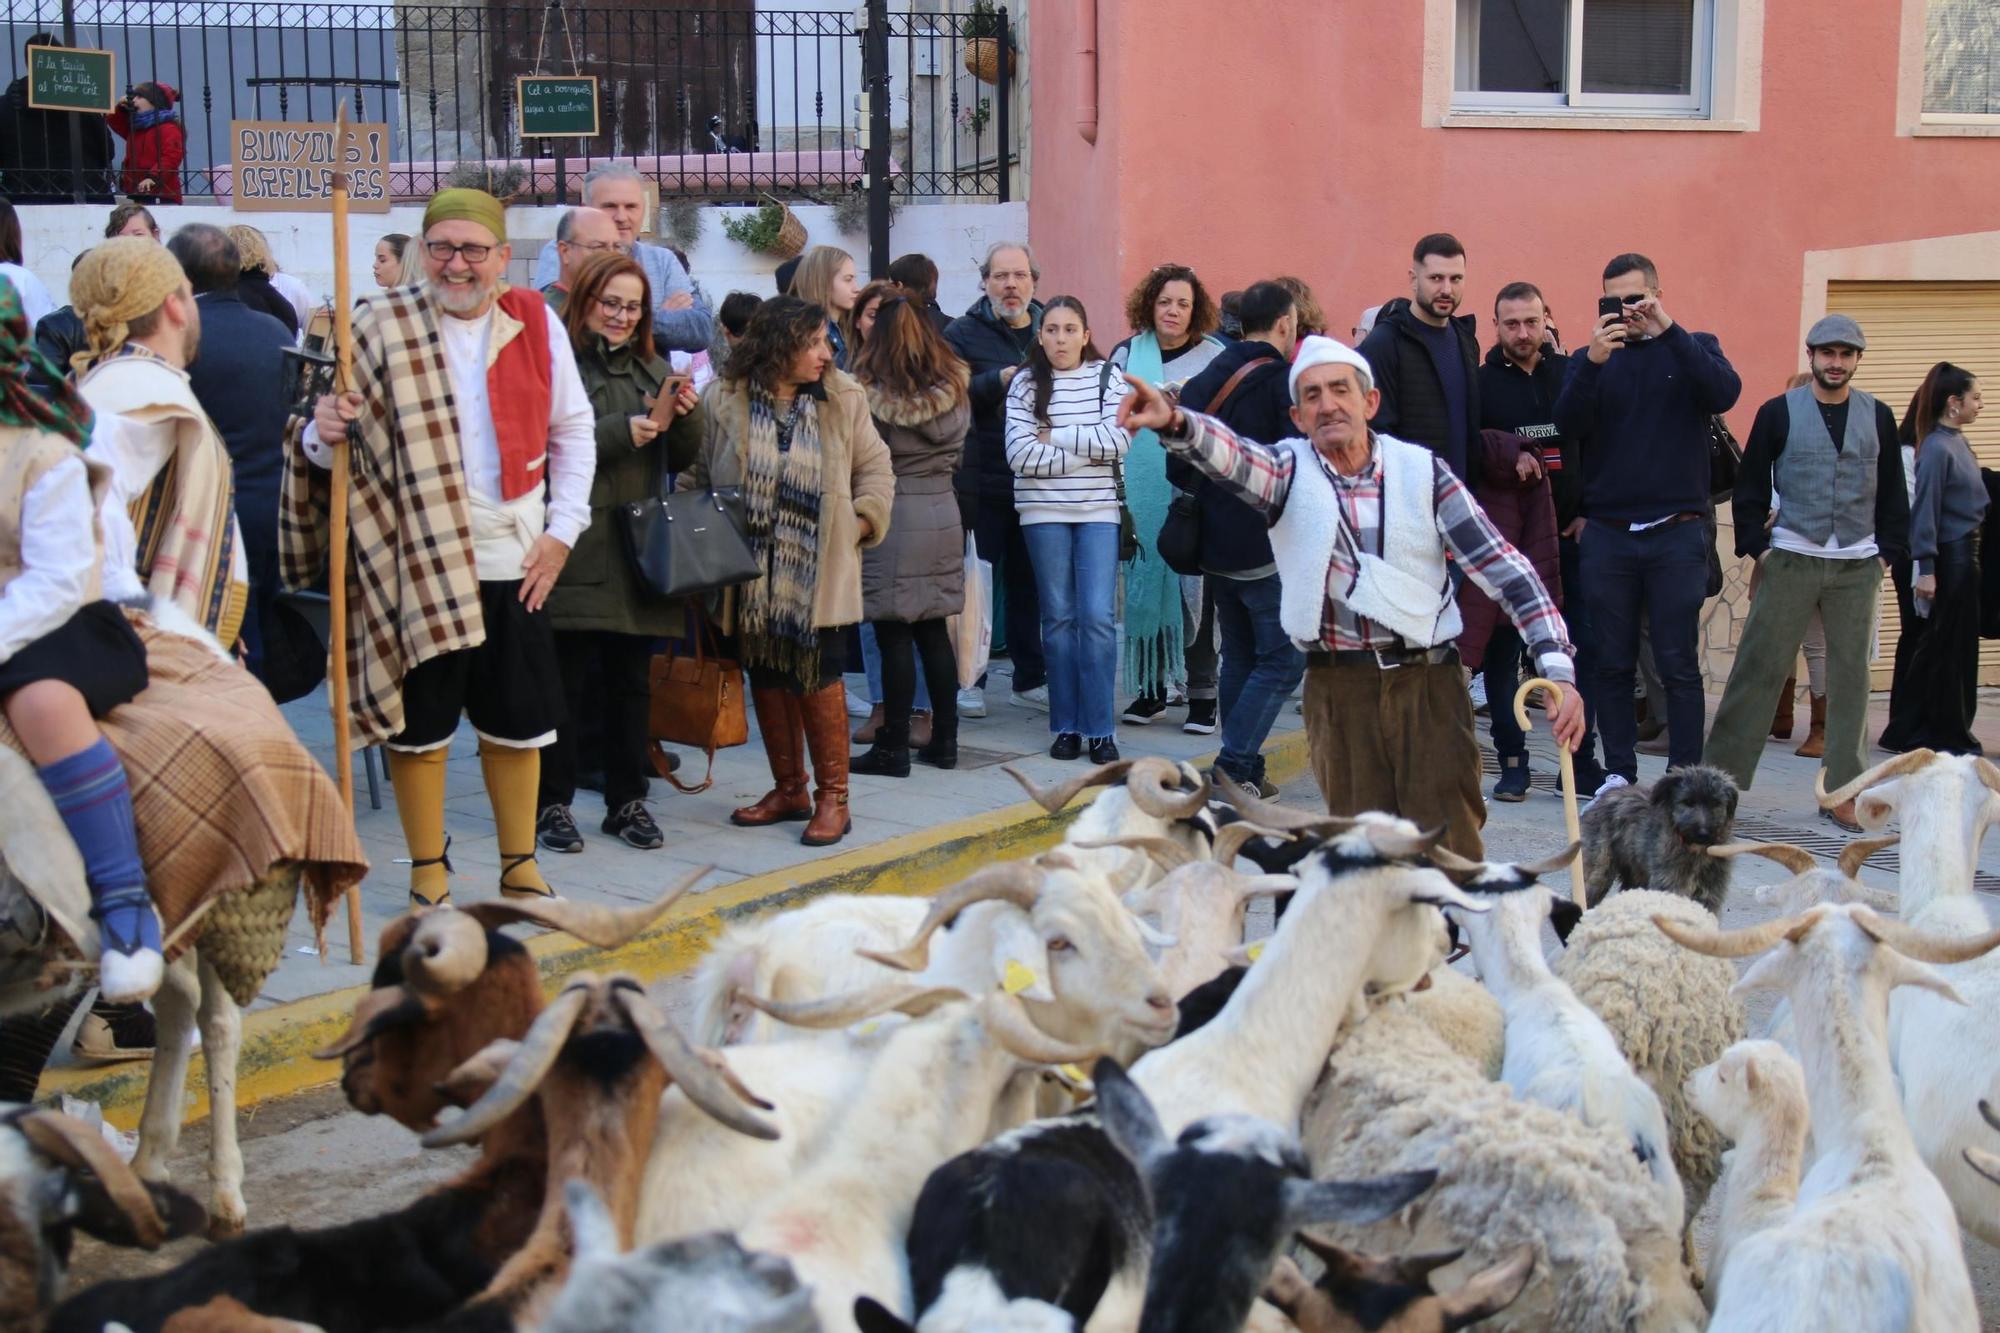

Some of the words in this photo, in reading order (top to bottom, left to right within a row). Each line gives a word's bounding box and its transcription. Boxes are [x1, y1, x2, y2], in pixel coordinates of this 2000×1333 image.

[544, 86, 552, 94] a
[548, 105, 555, 113] a
[368, 132, 381, 163] I
[241, 167, 384, 199] ORELLEES
[1515, 426, 1561, 438] NORWA
